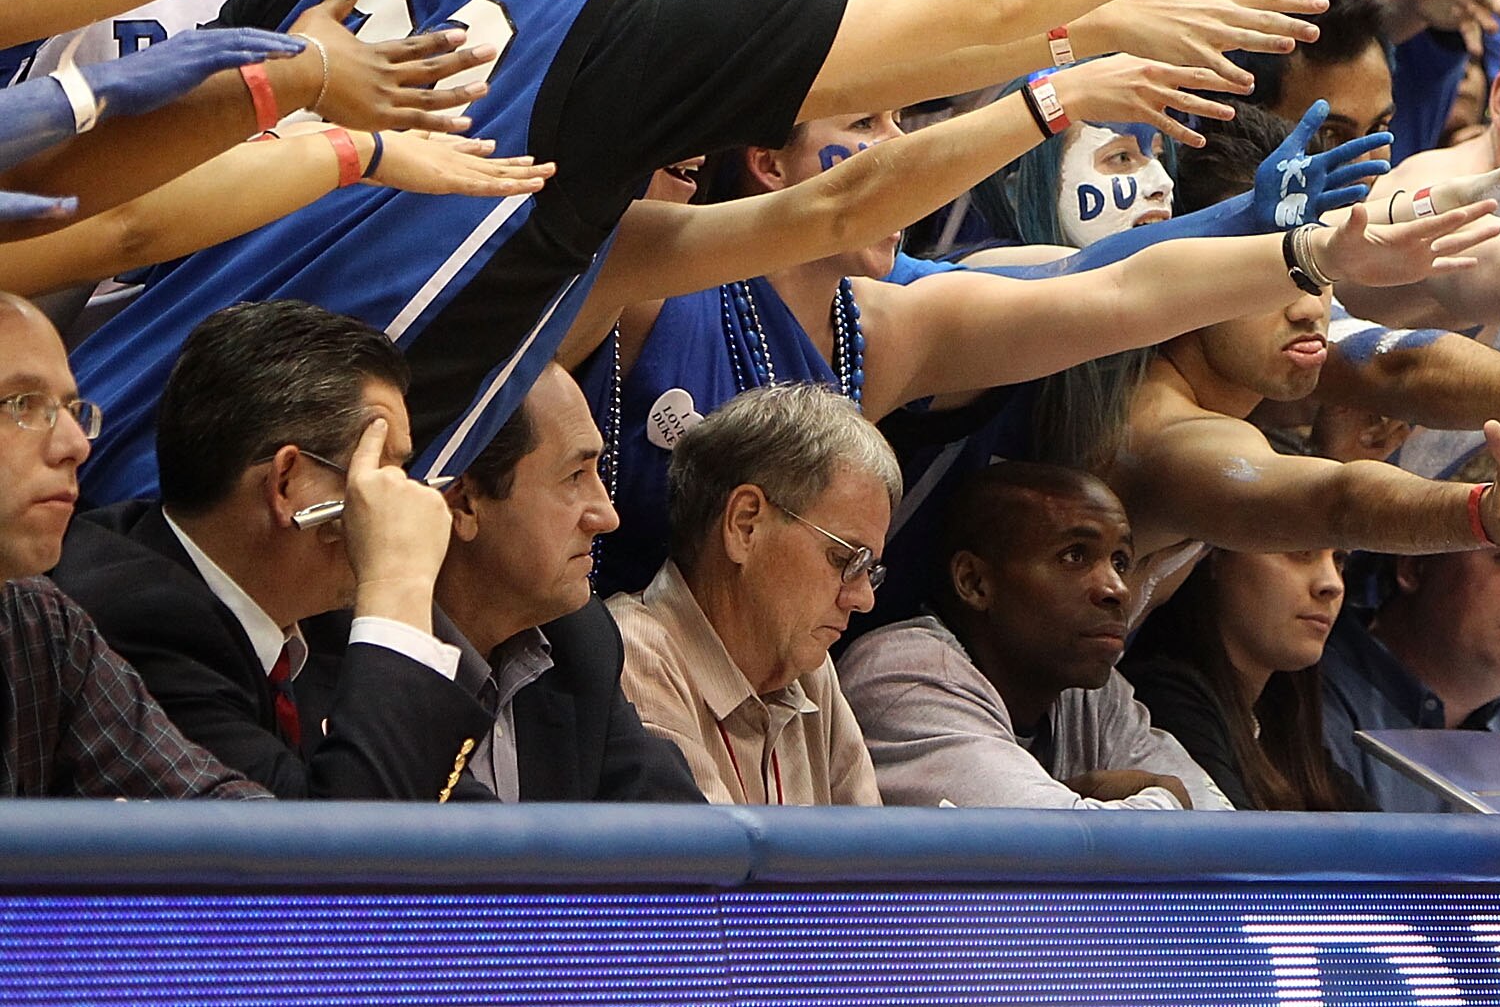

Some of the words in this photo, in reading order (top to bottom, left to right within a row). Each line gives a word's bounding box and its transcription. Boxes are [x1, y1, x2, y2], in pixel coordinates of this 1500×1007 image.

[1077, 176, 1137, 222] DU
[652, 412, 677, 446] DUKE
[681, 412, 690, 420] I
